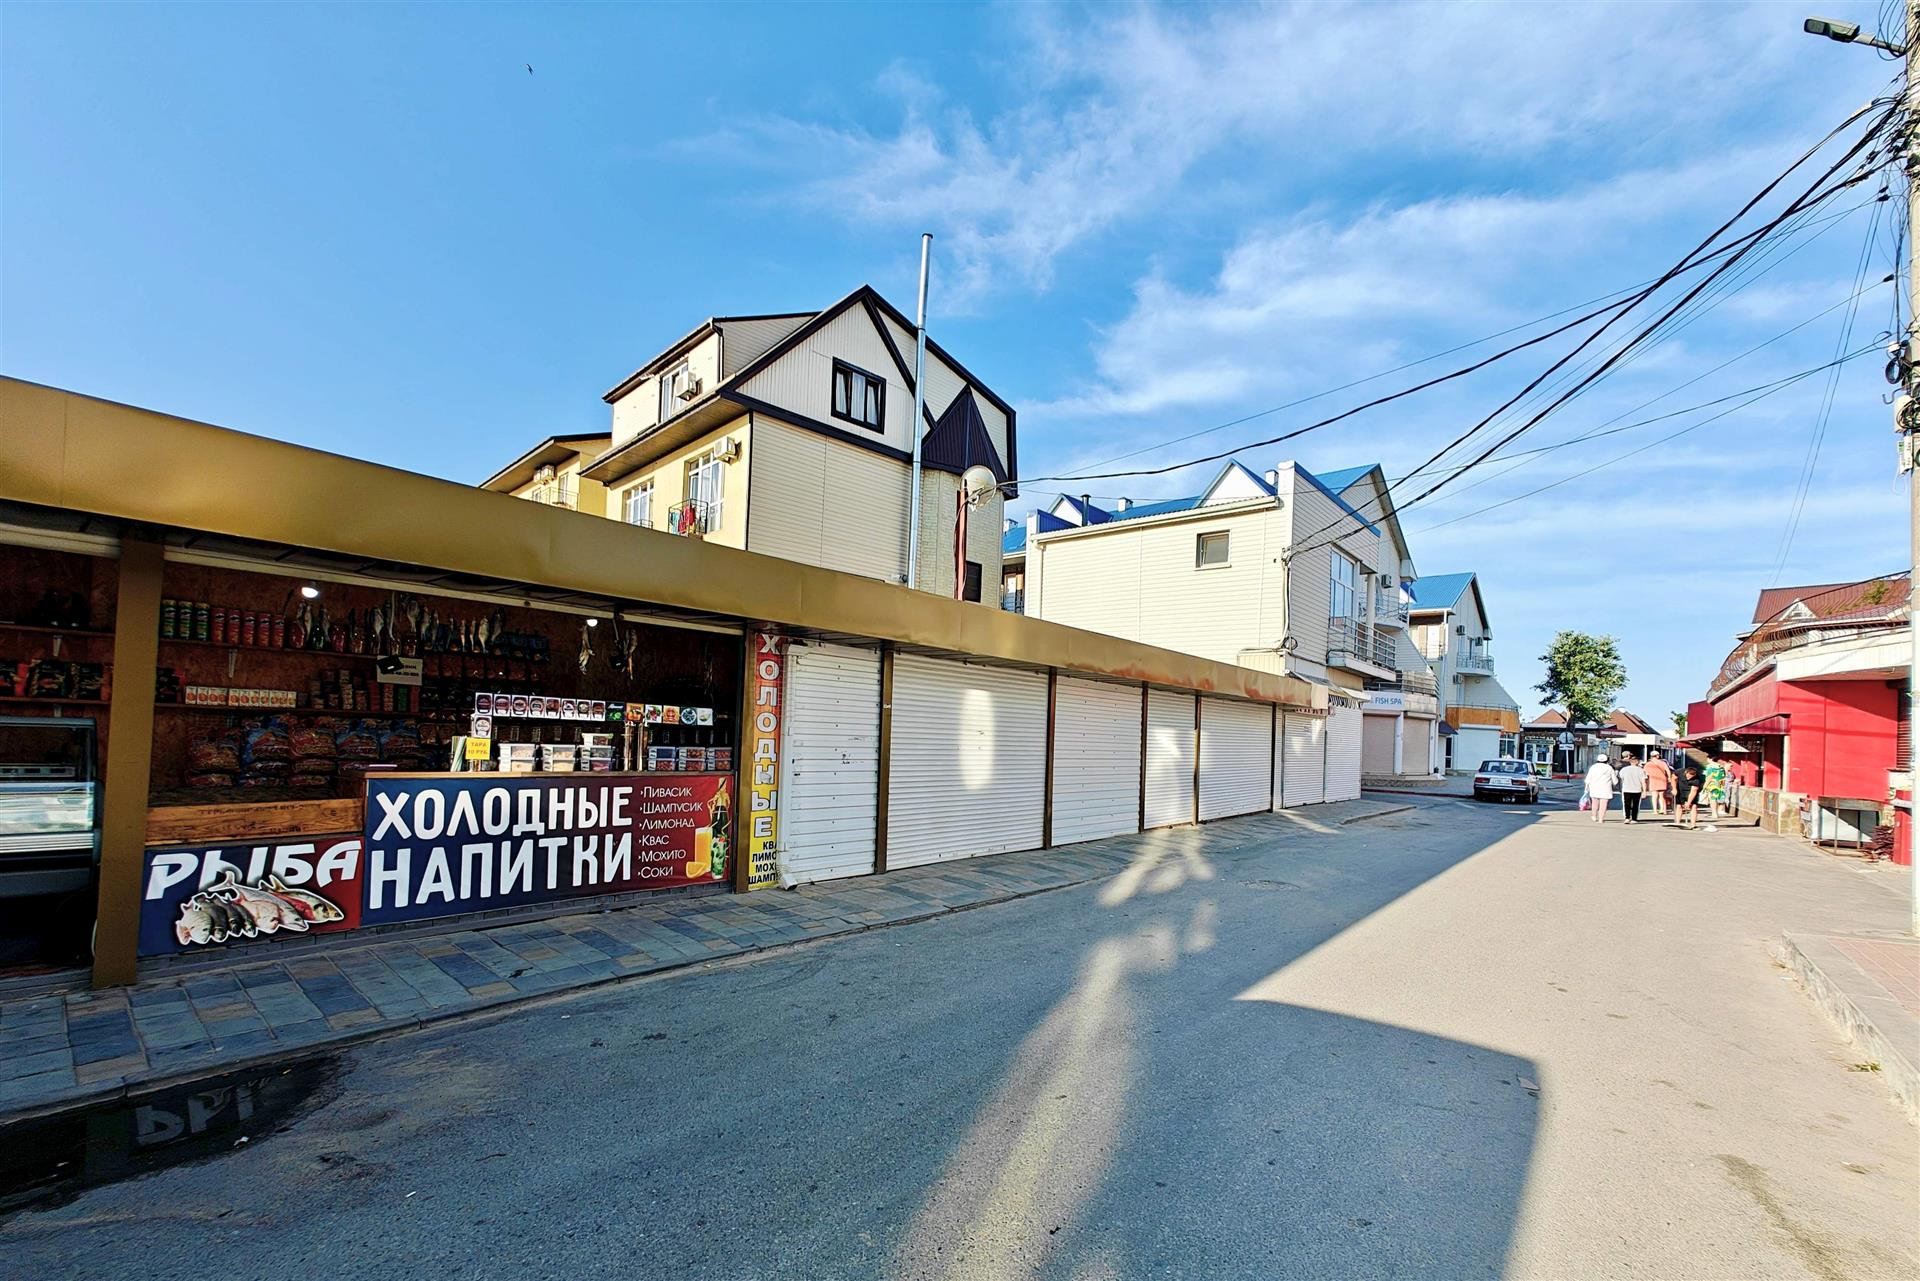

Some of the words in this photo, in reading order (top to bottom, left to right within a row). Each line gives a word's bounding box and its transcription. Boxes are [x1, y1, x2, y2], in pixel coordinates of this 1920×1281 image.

[1375, 697, 1389, 705] FISH
[752, 633, 780, 838] ХОЛОДНЫЕ
[643, 786, 692, 798] ПИВАСИК
[372, 786, 633, 841] ХОЛОДНЫЕ
[643, 802, 703, 814] ШАМПУСИК
[641, 818, 695, 830] ЛИМОНАД
[642, 835, 670, 846] КВАС
[641, 849, 687, 863] МОХИТО
[145, 840, 362, 900] РЫБА
[369, 832, 632, 909] НАПИТКИ
[640, 866, 674, 878] СОКИ
